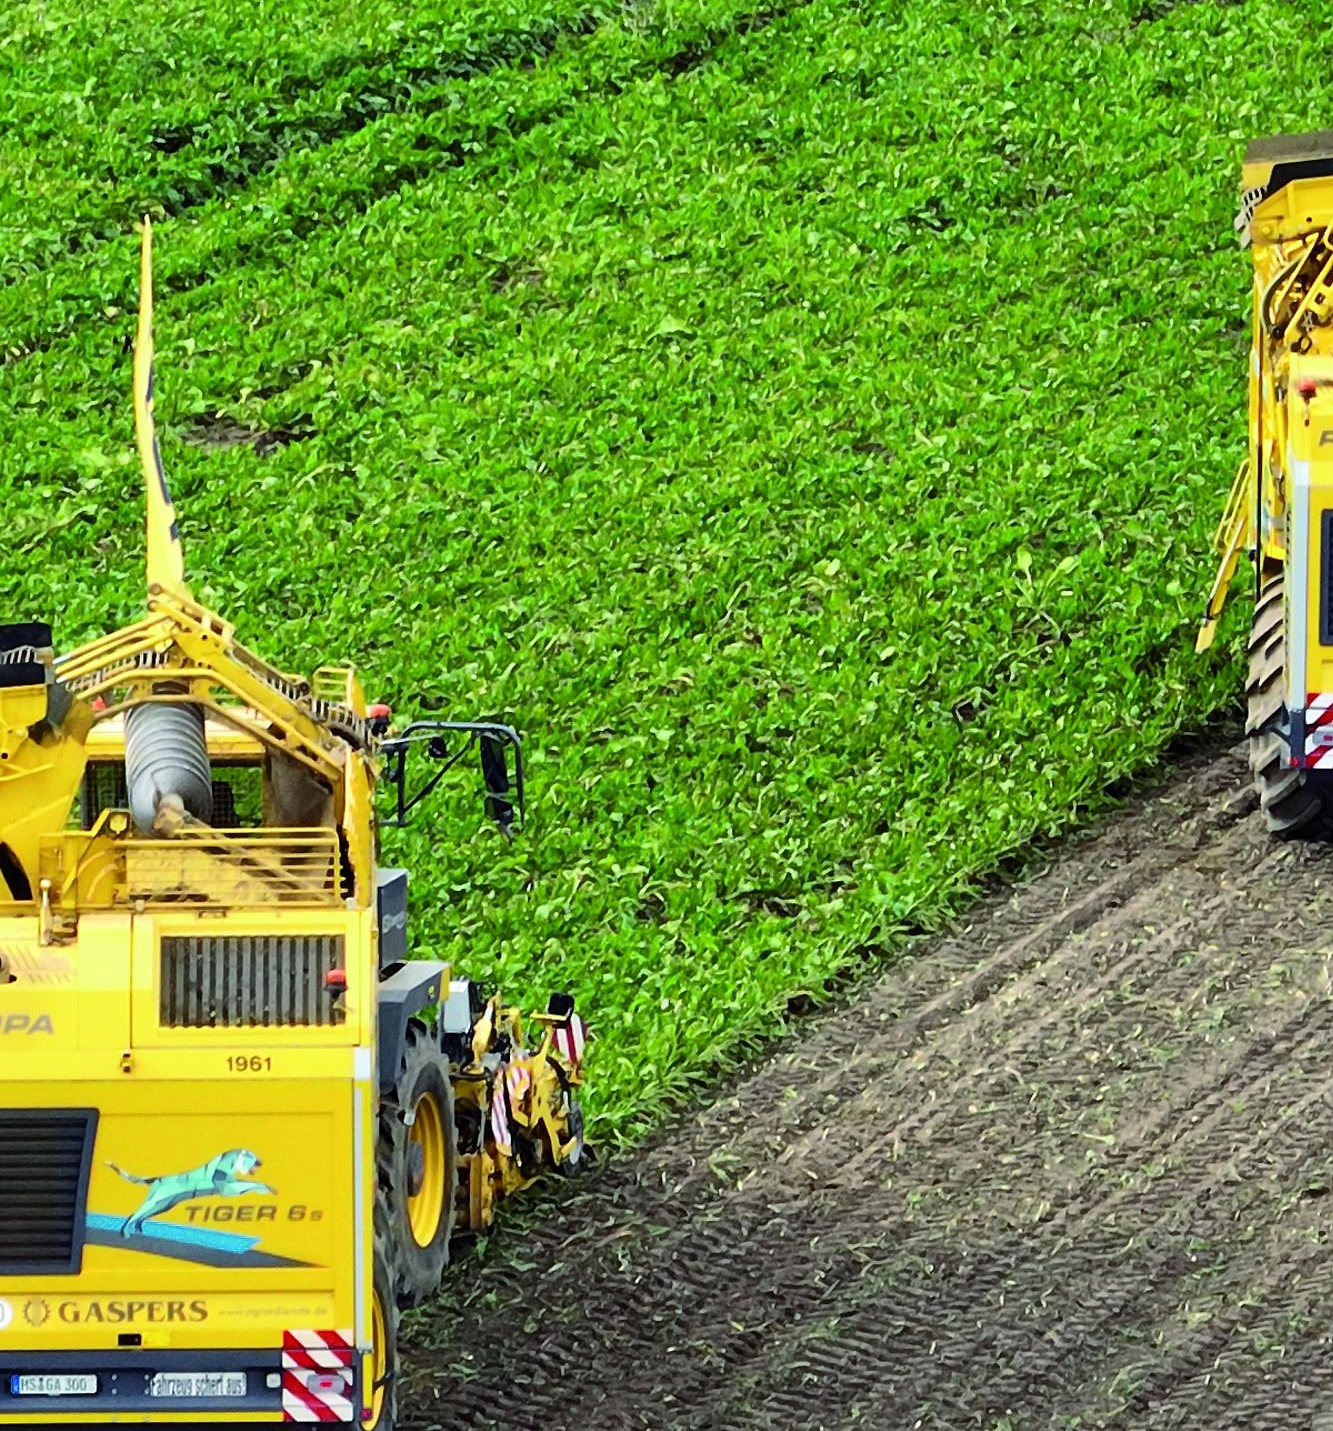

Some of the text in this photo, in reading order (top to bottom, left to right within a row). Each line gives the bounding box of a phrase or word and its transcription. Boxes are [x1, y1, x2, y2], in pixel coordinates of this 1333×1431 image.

[0, 1014, 55, 1035] PA
[226, 1055, 273, 1072] 1961
[185, 1206, 279, 1222] TIGER
[58, 1300, 209, 1323] GASPERS
[21, 1378, 37, 1391] HS
[46, 1377, 61, 1391] GA
